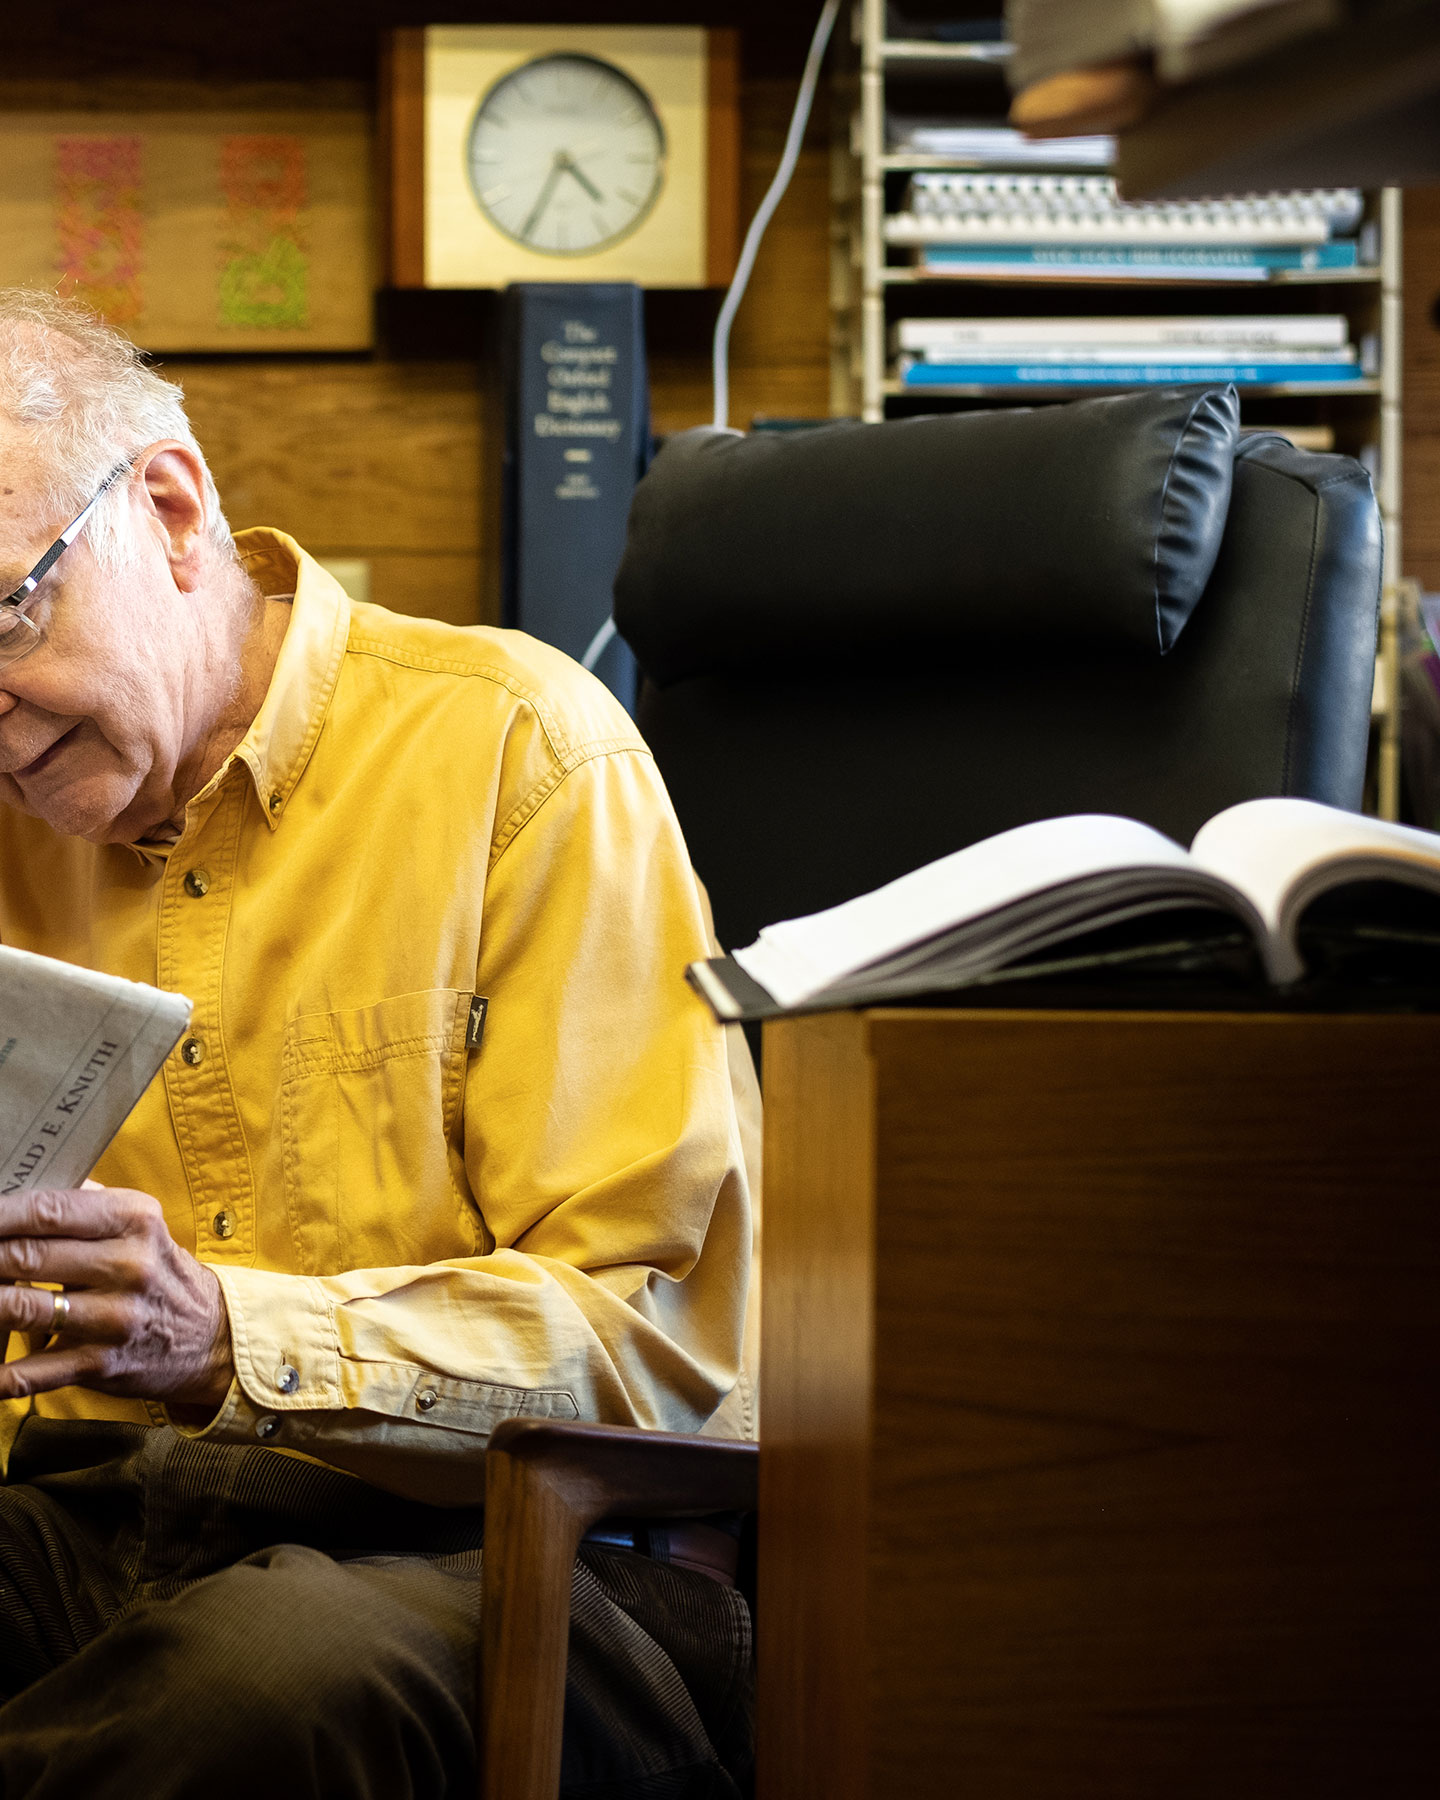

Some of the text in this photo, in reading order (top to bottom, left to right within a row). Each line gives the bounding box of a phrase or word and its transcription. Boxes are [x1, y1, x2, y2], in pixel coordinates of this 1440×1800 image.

[0, 1039, 119, 1196] NALD E. KNUTH
